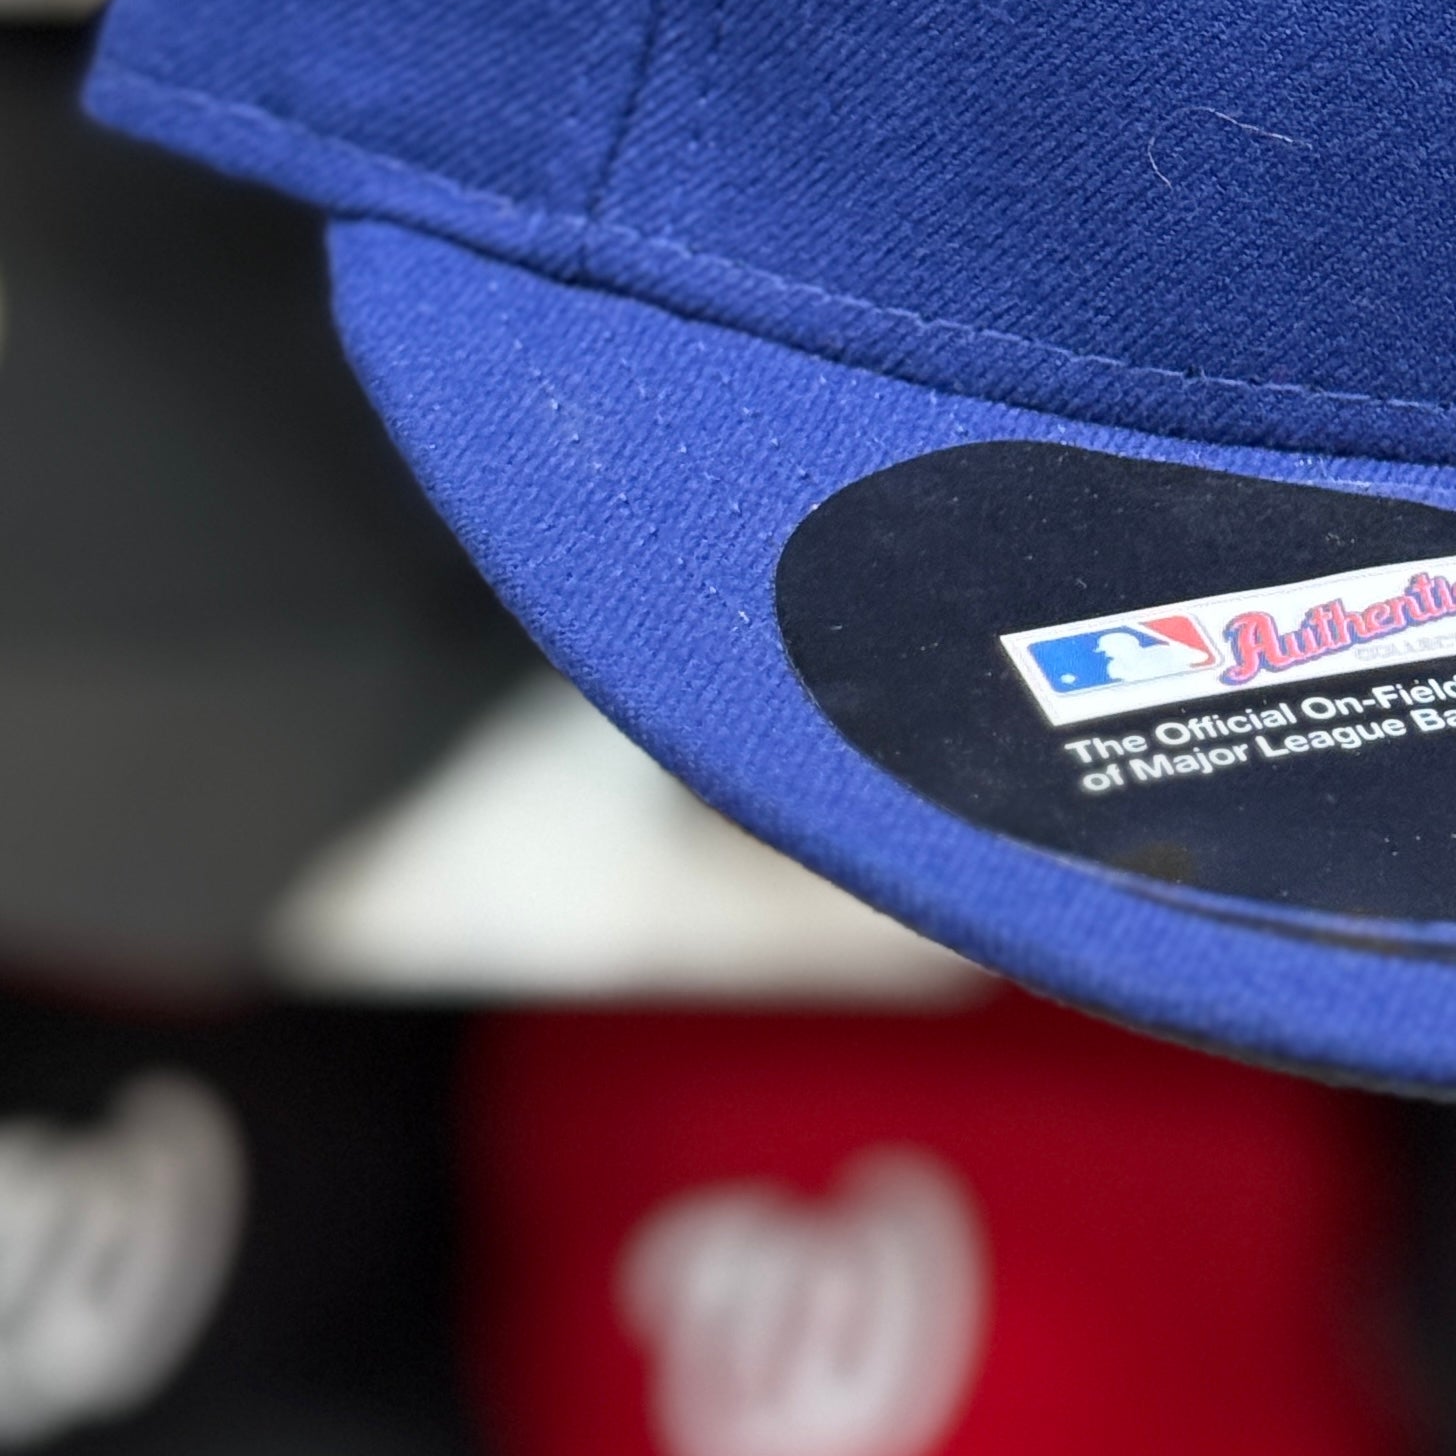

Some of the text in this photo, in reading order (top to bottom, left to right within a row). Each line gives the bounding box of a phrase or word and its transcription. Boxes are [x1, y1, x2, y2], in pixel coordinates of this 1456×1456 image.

[1064, 734, 1148, 763] The
[1155, 702, 1298, 746] Official
[1082, 763, 1125, 792] of
[1128, 743, 1249, 774] Major
[1255, 717, 1407, 758] League
